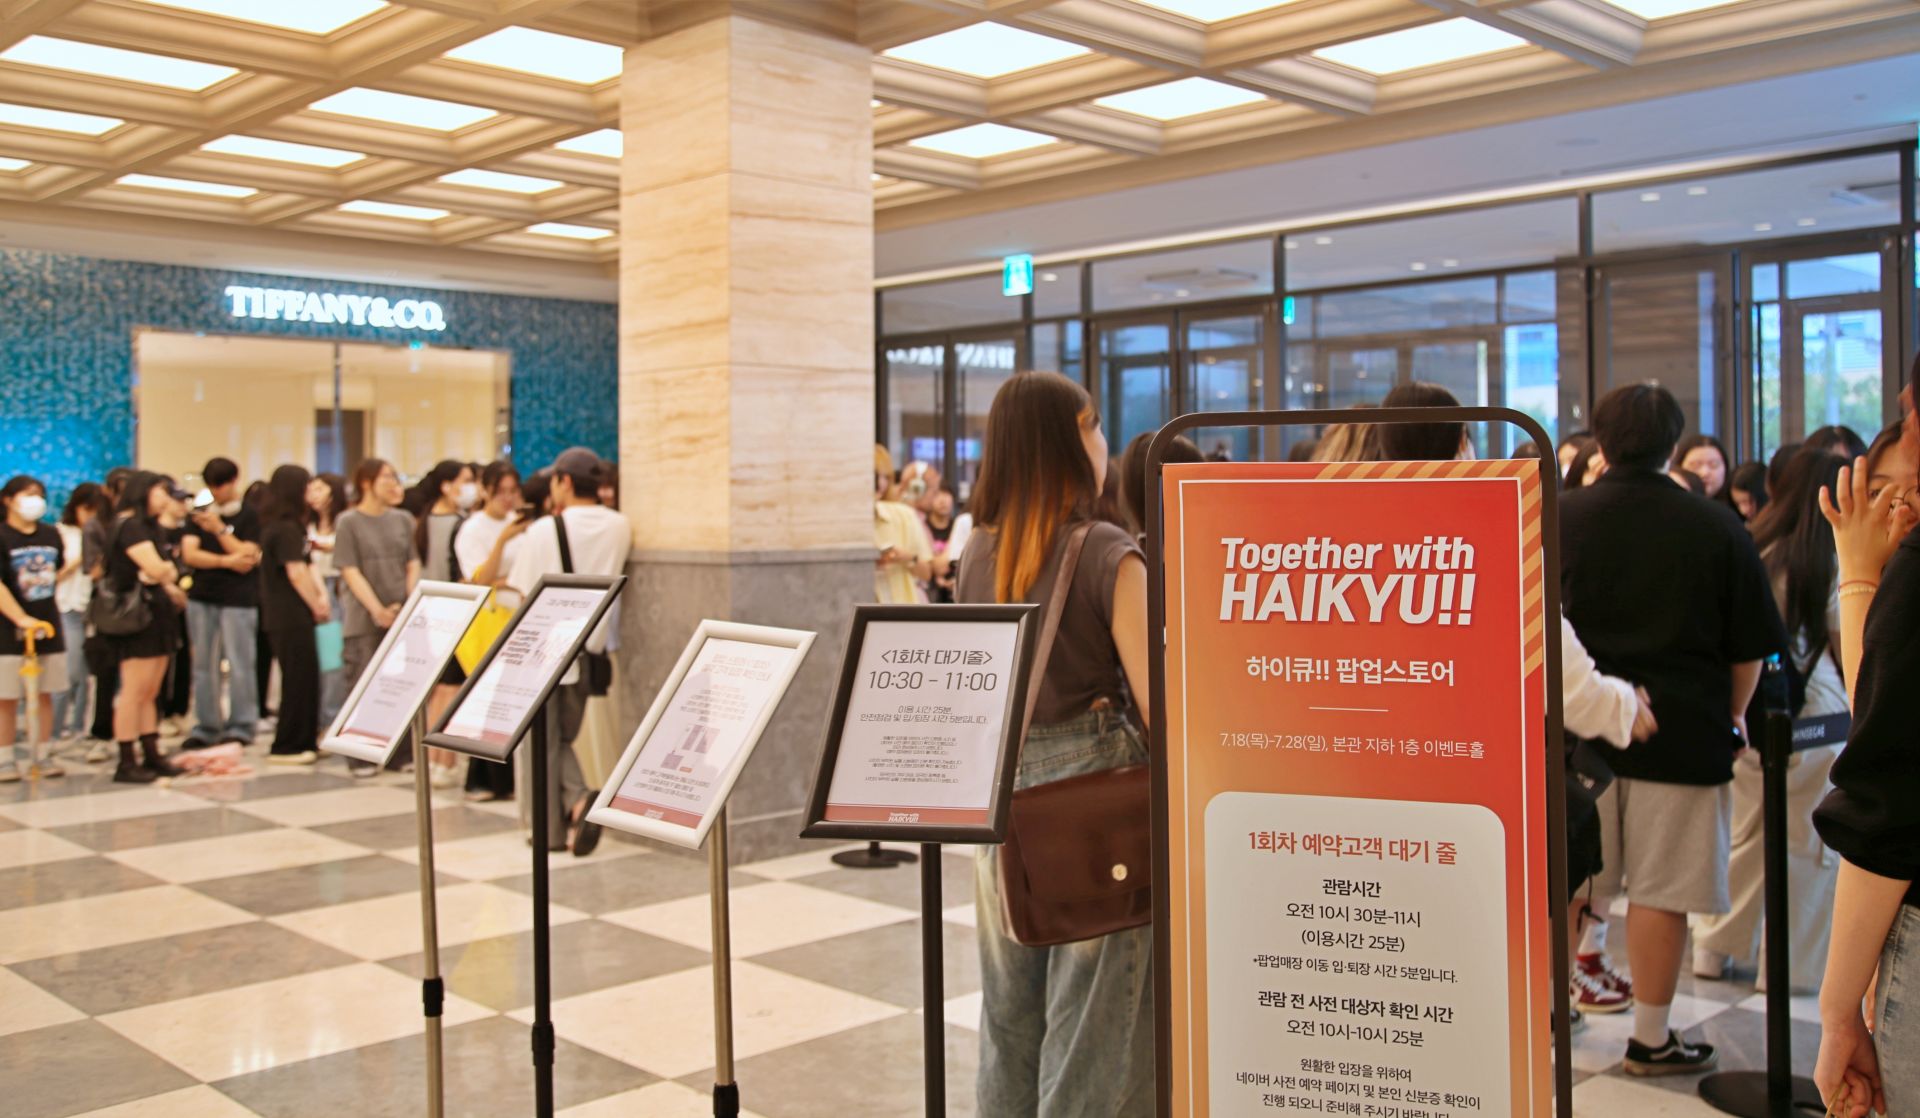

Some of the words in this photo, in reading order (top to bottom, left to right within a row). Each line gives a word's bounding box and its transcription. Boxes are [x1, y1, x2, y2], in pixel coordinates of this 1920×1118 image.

[1220, 536, 1382, 571] Together
[1394, 536, 1475, 570] with
[1219, 573, 1476, 626] HAIKYU!!
[882, 650, 931, 664] <1회차
[934, 650, 992, 665] 대기줄>
[1246, 656, 1329, 683] 하이큐!!
[1336, 658, 1454, 686] 팝업스토어
[870, 671, 923, 689] 10:30
[946, 672, 997, 690] 11:00
[916, 706, 932, 714] 시간
[1219, 732, 1328, 752] 7.18(목)-7.28(일),
[1332, 737, 1361, 754] 본관
[1365, 738, 1395, 755] 지하
[1399, 740, 1418, 756] 1층
[1425, 740, 1484, 759] 이벤트홀
[1247, 831, 1297, 854] 1회차
[1302, 834, 1382, 860] 예약고객
[1389, 840, 1429, 863] 대기
[1435, 842, 1457, 865] 줄
[1322, 878, 1381, 898] 관람시간
[1286, 902, 1314, 920] 오전
[1318, 904, 1349, 922] 10시
[1354, 907, 1421, 928] 30분-11시
[1301, 929, 1364, 949] (이용시간
[1368, 933, 1405, 952] 25분)
[1306, 957, 1329, 973] 이동
[1374, 963, 1397, 978] 시간
[1400, 965, 1458, 984] 5분입니다.
[1258, 990, 1286, 1008] 관람
[1291, 993, 1304, 1010] 전
[1309, 995, 1337, 1012] 사전
[1342, 998, 1385, 1018] 대상자
[1390, 1002, 1418, 1020] 확인
[1424, 1005, 1453, 1024] 시간
[1286, 1019, 1315, 1036] 오전
[1320, 1022, 1388, 1043] 10시-10시
[1392, 1028, 1424, 1047] 25분
[1300, 1058, 1335, 1073] 원활한
[1338, 1061, 1374, 1078] 입장을
[1376, 1064, 1412, 1082] 위하여
[1236, 1071, 1270, 1087] 네이버
[1274, 1075, 1296, 1089] 사전
[1299, 1077, 1322, 1092] 예약
[1325, 1080, 1360, 1096] 페이지
[1363, 1084, 1375, 1099] 및
[1378, 1084, 1402, 1100] 본인
[1405, 1088, 1441, 1105] 신분증
[1444, 1093, 1481, 1110] 확인이
[1263, 1094, 1285, 1110] 진행
[1288, 1096, 1323, 1113] 되오니
[1326, 1100, 1360, 1116] 준비해
[1364, 1104, 1399, 1118] 주시기
